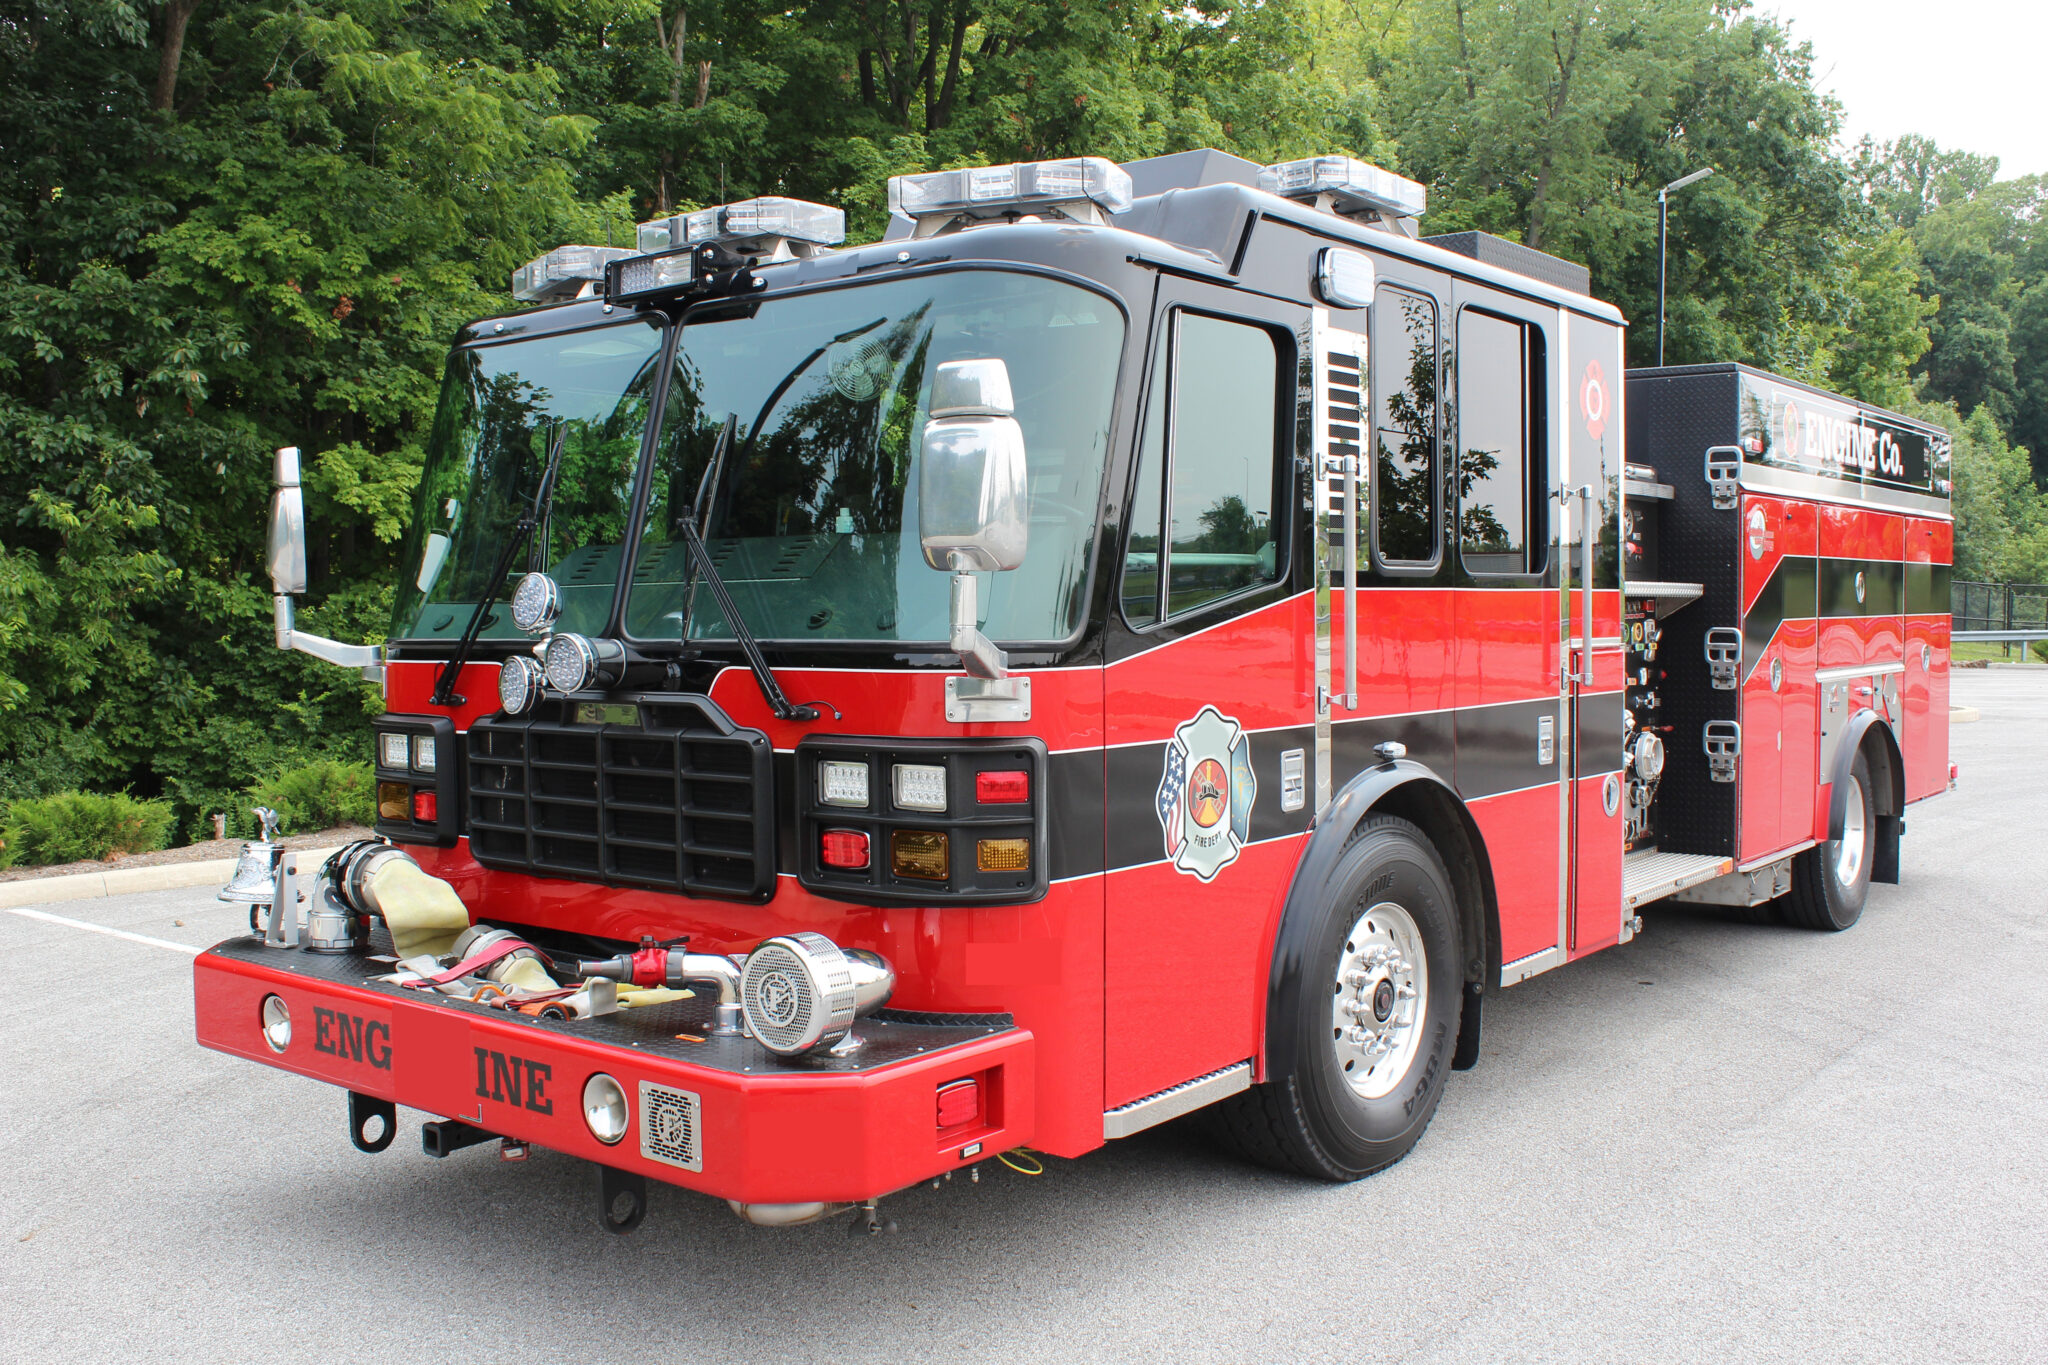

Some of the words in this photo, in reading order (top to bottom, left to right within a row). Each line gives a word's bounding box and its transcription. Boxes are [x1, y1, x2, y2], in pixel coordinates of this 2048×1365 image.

[1804, 410, 1877, 470] ENGINE
[1880, 431, 1904, 476] Co.
[1194, 834, 1207, 848] FIRE
[1208, 830, 1222, 847] DEPT
[313, 1006, 392, 1071] ENG
[474, 1046, 553, 1116] INE
